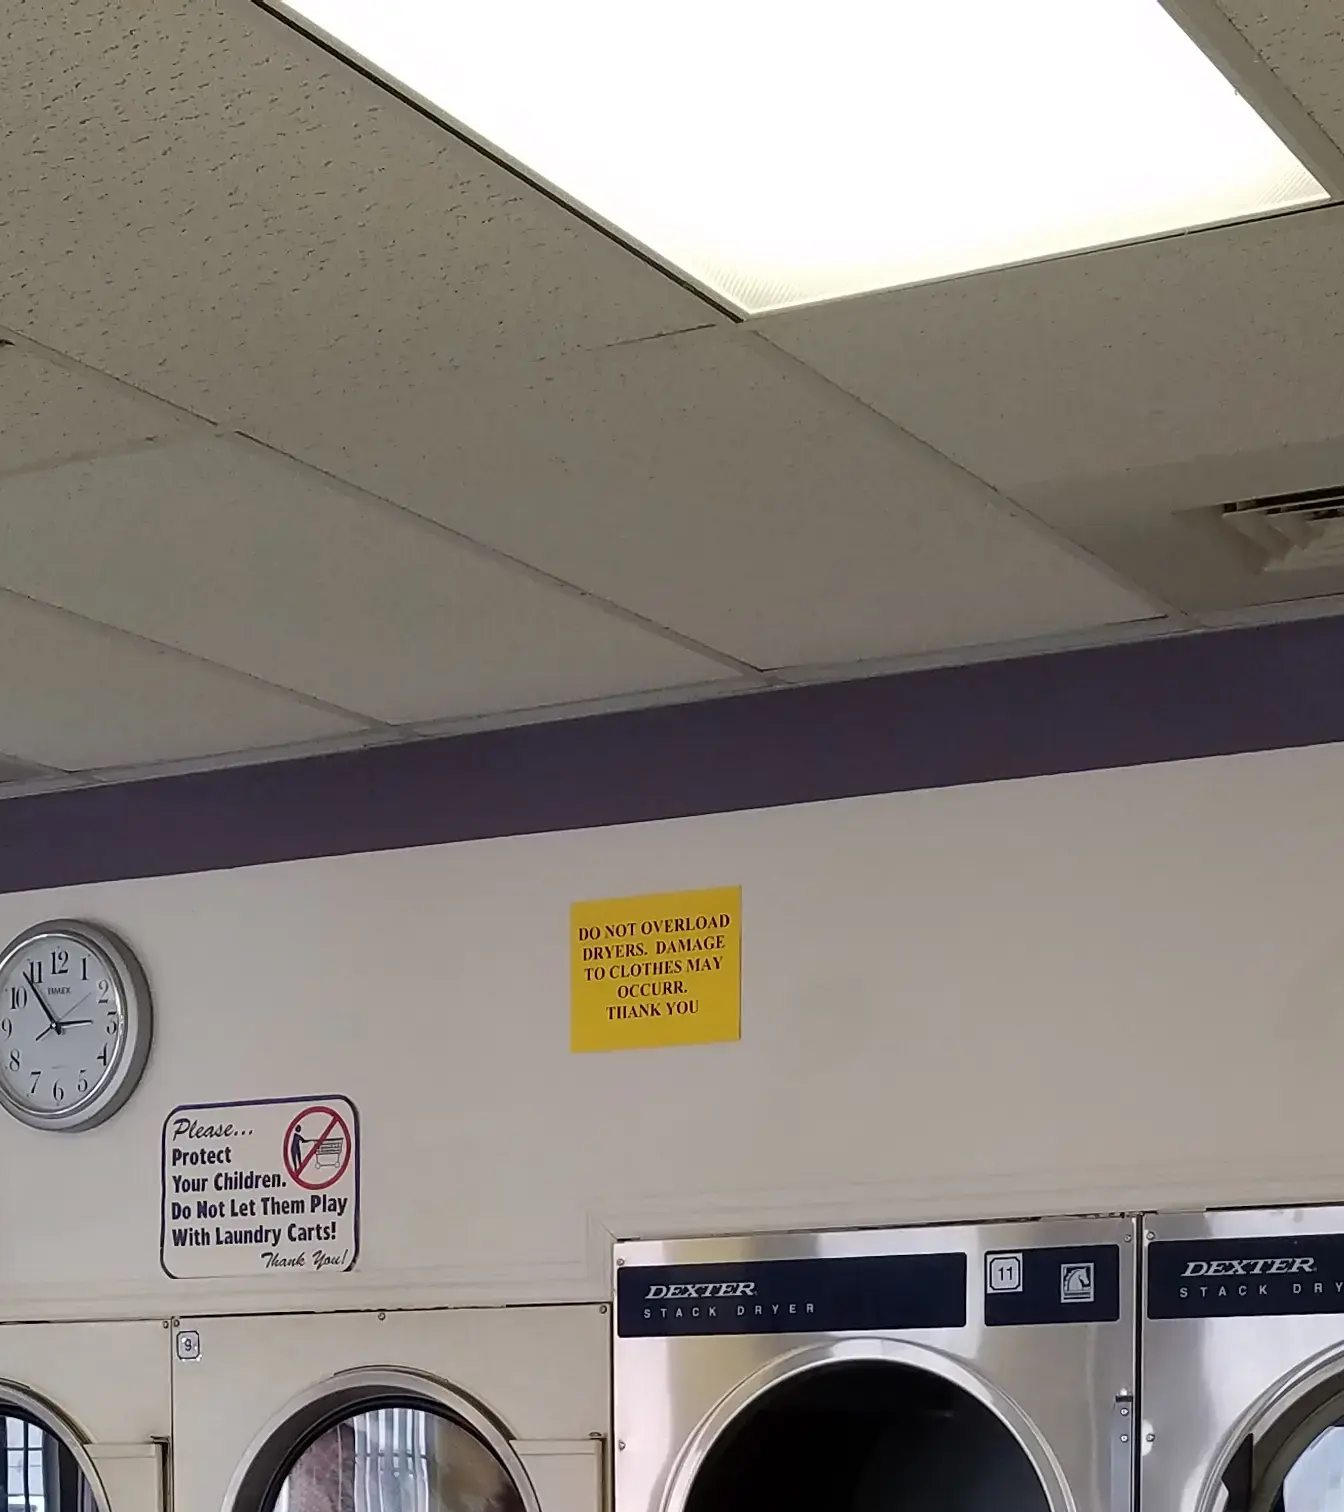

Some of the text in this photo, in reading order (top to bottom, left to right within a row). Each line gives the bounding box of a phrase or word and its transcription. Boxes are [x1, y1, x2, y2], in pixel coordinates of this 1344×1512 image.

[579, 914, 730, 940] DO NOT OVERLOAD
[583, 935, 726, 961] DRYERS. DAMAGE
[30, 961, 43, 983] 11
[50, 951, 69, 974] 12
[82, 957, 89, 980] 1
[584, 956, 723, 981] TO CLOTHES MAY
[10, 987, 27, 1010] 10
[48, 987, 71, 995] TIMEX
[98, 980, 108, 1003] 2
[618, 980, 687, 999] OCCURR.
[606, 1000, 699, 1020] THANK YOU
[2, 1018, 12, 1039] 9
[107, 1011, 117, 1035] 3
[9, 1050, 20, 1071] 8
[97, 1043, 107, 1066] 4
[31, 1071, 41, 1093] 7
[53, 1079, 64, 1101] 6
[78, 1070, 88, 1092] 5
[173, 1118, 253, 1141] Please...
[172, 1147, 231, 1166] Protect
[172, 1172, 286, 1193] Your Children.
[172, 1195, 348, 1220] Do Not Let Them Play
[172, 1222, 336, 1247] With Laundry Carts!
[261, 1249, 348, 1270] Thank You!
[1181, 1256, 1316, 1276] DEXTER
[997, 1267, 1013, 1281] 11
[645, 1282, 756, 1299] DEXTER
[1180, 1285, 1267, 1298] STACK
[644, 1303, 815, 1318] STACK DRYER
[184, 1338, 192, 1351] 9
